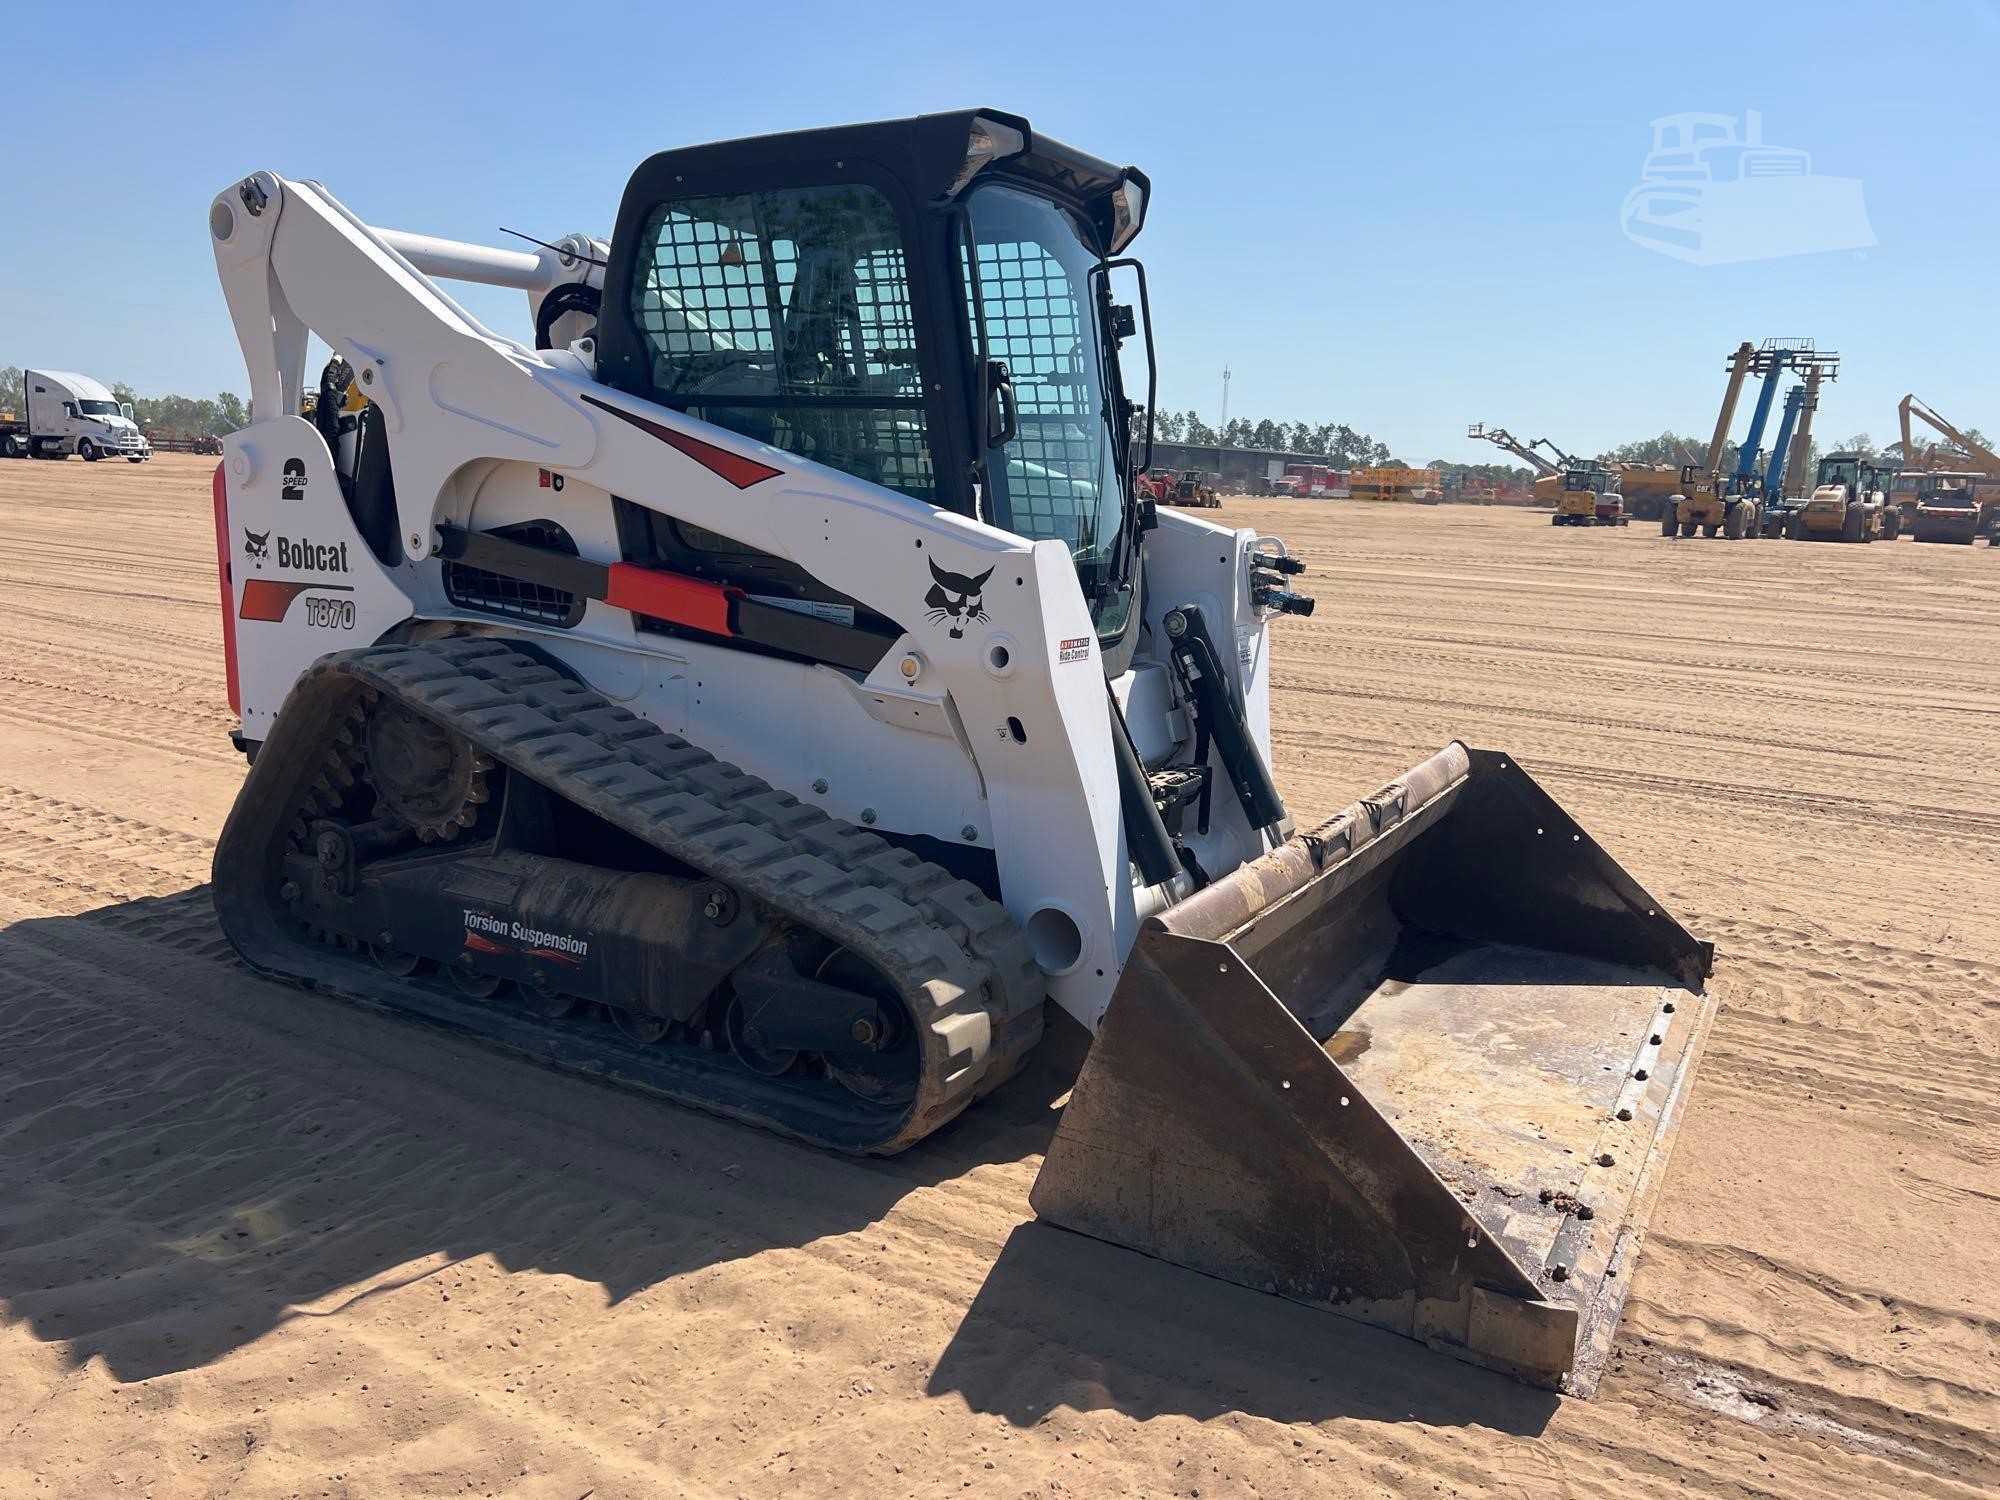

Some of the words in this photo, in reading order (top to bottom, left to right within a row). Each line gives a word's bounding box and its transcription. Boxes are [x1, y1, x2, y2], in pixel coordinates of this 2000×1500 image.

[282, 457, 306, 500] 2
[282, 476, 308, 486] SPEED
[277, 536, 349, 573] Bobcat
[306, 597, 356, 630] T870
[1059, 650, 1071, 661] Ride
[1071, 647, 1090, 660] Control
[1060, 638, 1090, 649] AUTOMATIC
[463, 909, 509, 936] Torsion
[511, 921, 588, 956] Suspension
